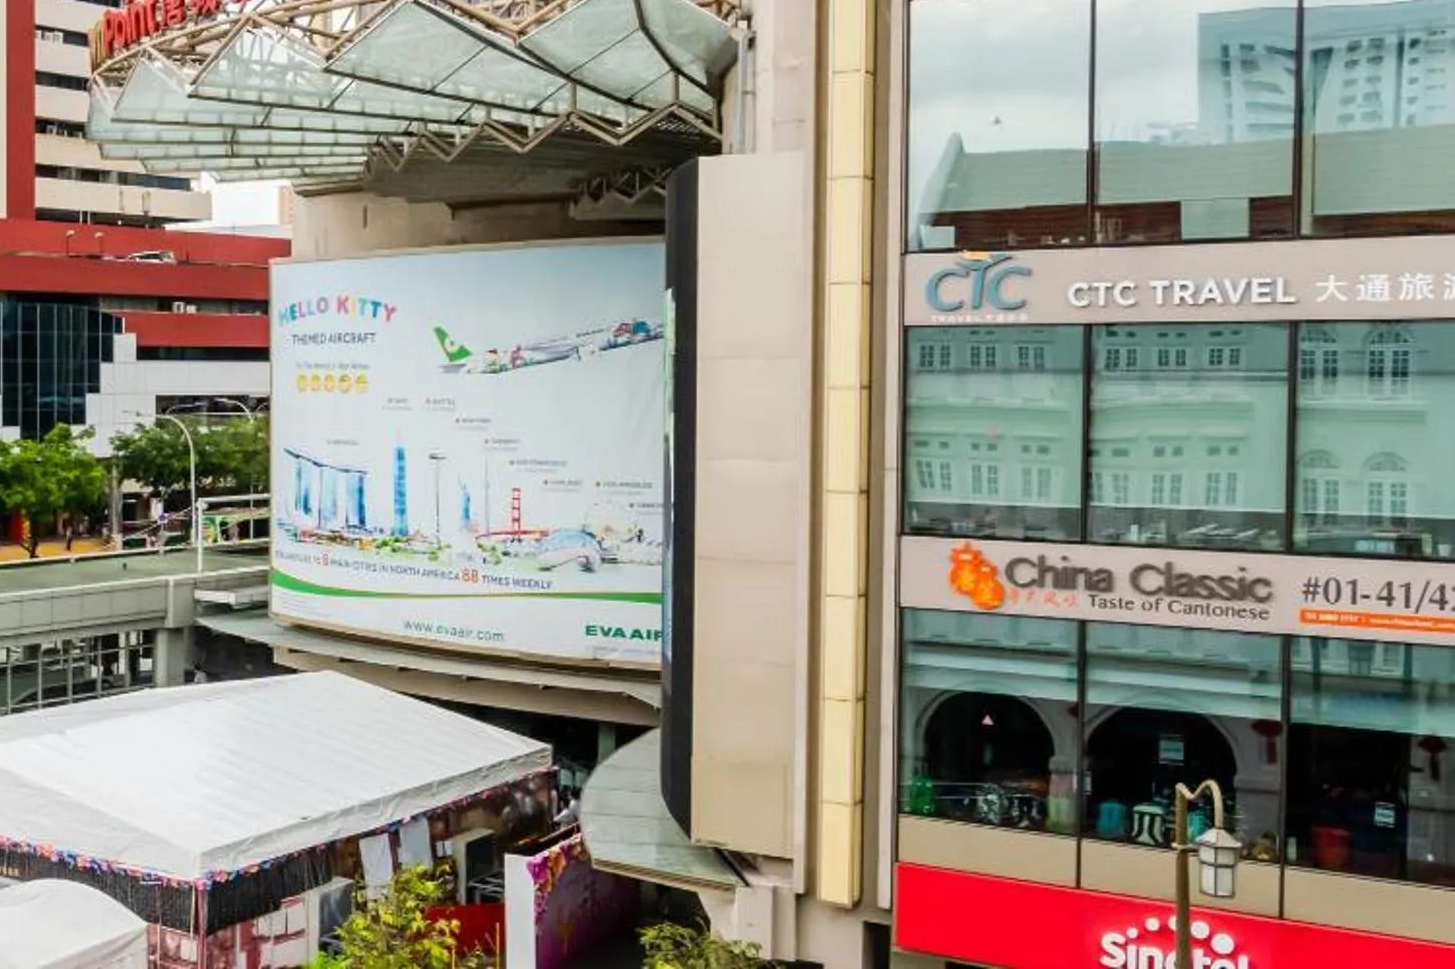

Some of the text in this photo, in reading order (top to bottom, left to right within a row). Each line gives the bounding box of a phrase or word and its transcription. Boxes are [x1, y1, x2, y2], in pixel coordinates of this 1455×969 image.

[925, 252, 1033, 312] CTC
[1067, 281, 1138, 308] CTC
[1149, 277, 1298, 307] TRAVEL
[278, 294, 396, 327] HELLO KITTY
[291, 332, 376, 345] THEMED AIRCRAFT
[322, 554, 331, 567] 8
[461, 569, 479, 583] 88
[482, 574, 510, 586] TIMES
[512, 577, 553, 590] WEEKLY
[1004, 554, 1273, 603] China Classic
[1088, 594, 1134, 611] Taste
[1142, 597, 1162, 612] of
[1167, 599, 1270, 620] Cantonese
[1301, 576, 1455, 614] #01-41/4
[403, 620, 505, 642] www.evaair.com
[585, 625, 626, 639] EVA
